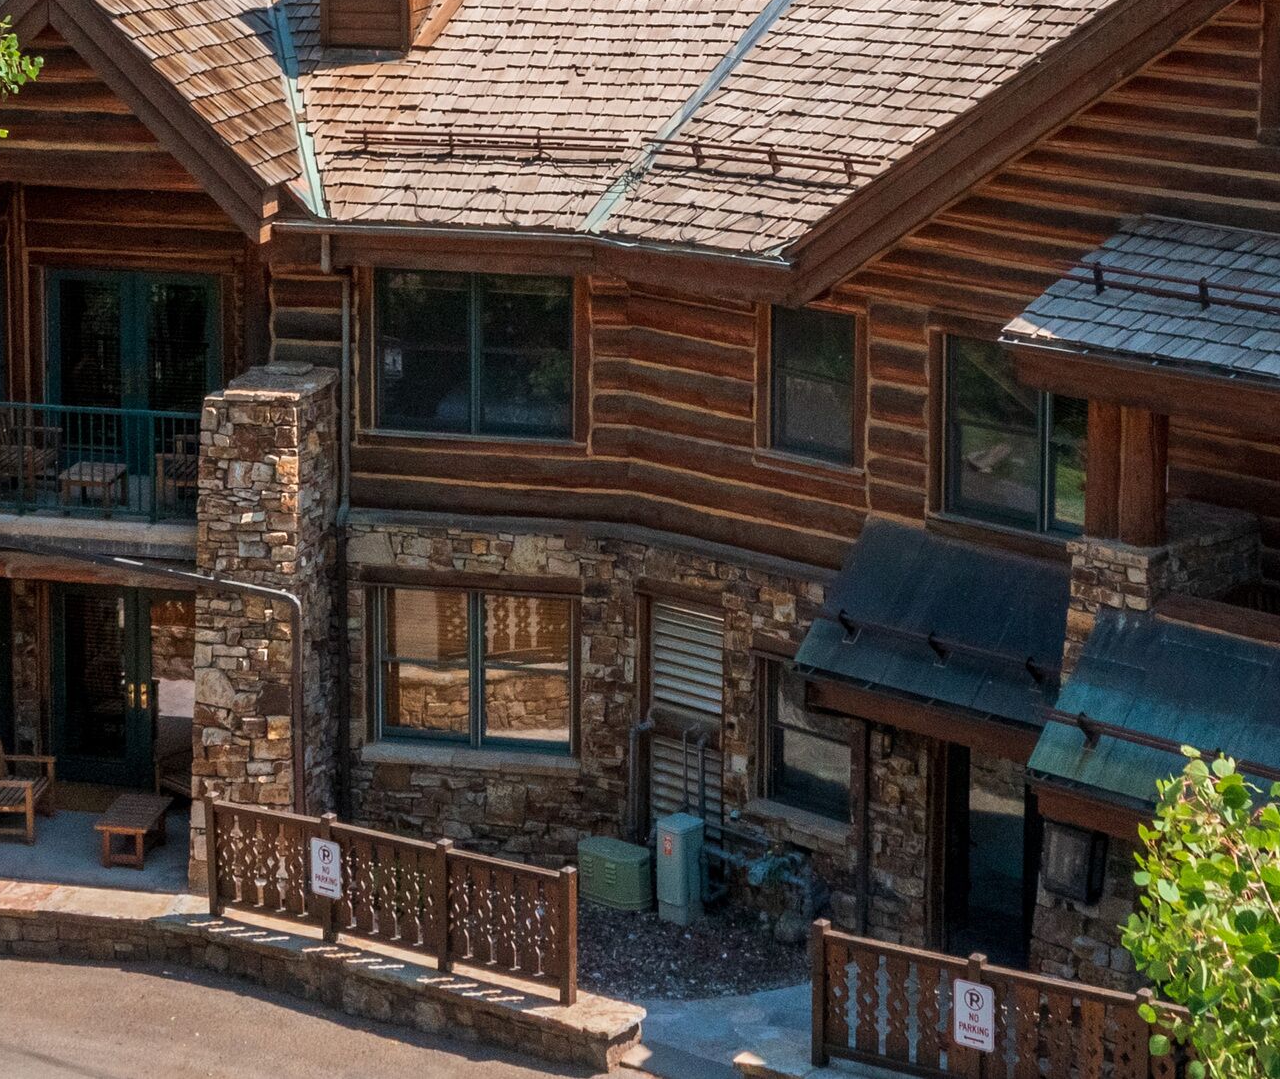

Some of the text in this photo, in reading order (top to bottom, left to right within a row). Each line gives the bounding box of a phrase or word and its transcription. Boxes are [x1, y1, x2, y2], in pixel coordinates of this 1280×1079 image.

[322, 866, 330, 875] NO
[315, 874, 337, 887] PARKING
[969, 1013, 979, 1023] NO
[959, 1021, 989, 1038] PARKING
